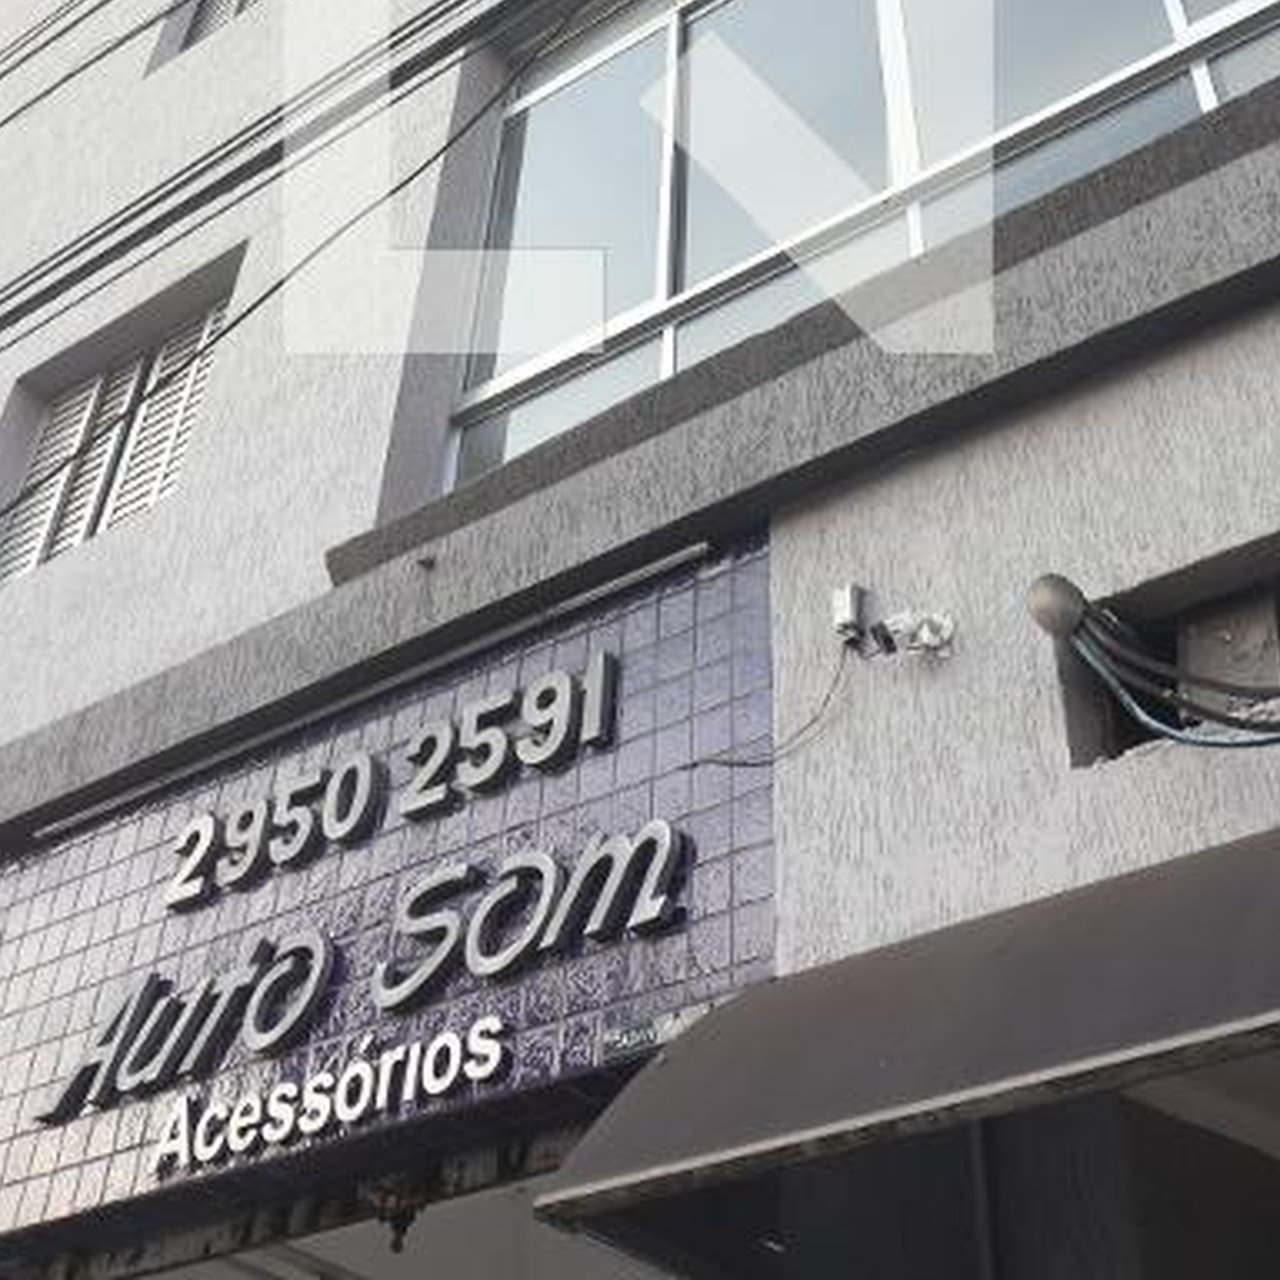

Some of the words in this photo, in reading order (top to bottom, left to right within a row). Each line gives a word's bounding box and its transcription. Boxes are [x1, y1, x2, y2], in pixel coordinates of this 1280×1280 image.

[165, 751, 380, 914] 2950
[400, 650, 618, 821] 2591
[371, 818, 688, 1014] Som
[152, 1017, 504, 1175] Acessórios
